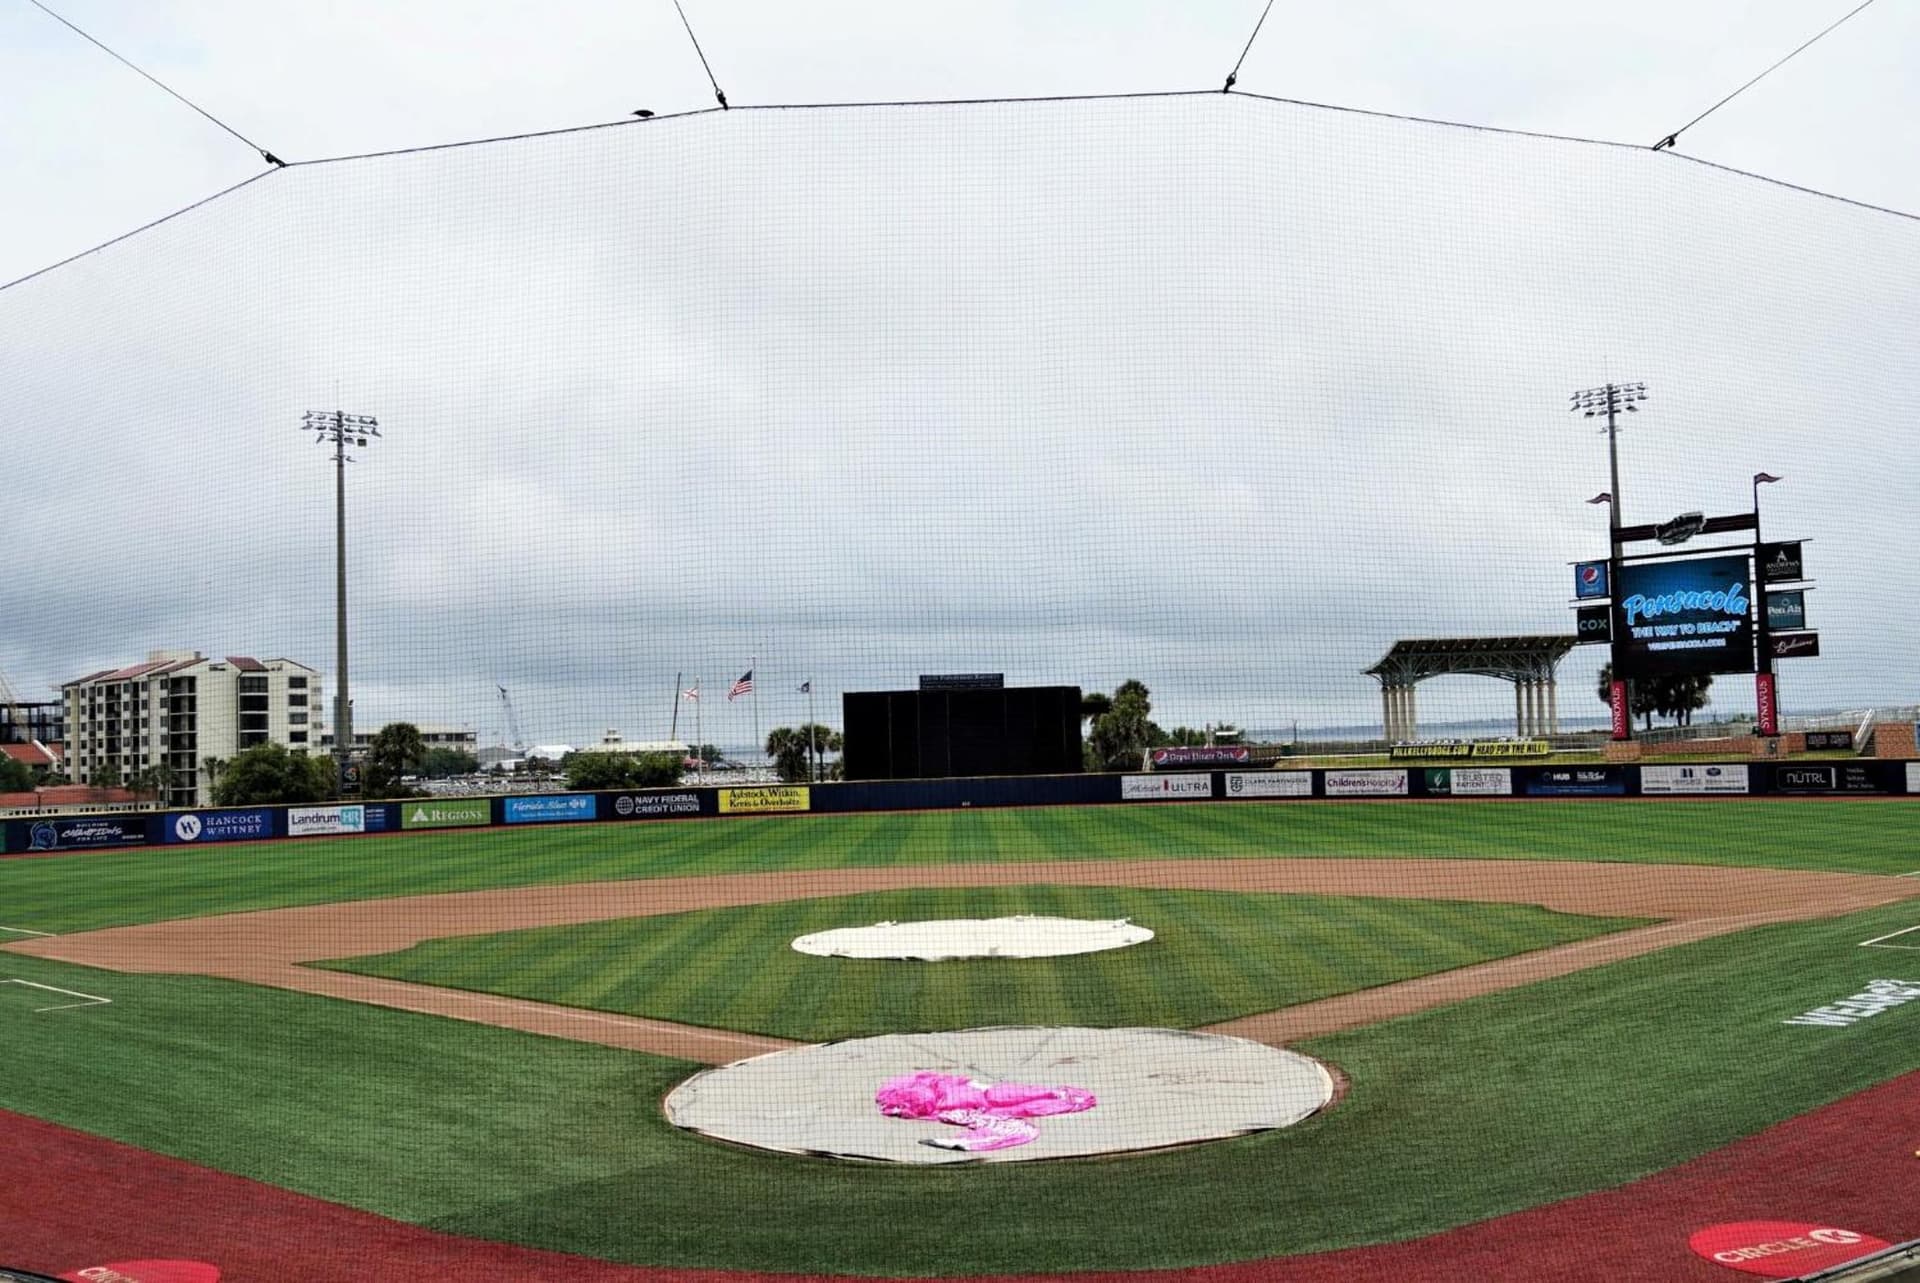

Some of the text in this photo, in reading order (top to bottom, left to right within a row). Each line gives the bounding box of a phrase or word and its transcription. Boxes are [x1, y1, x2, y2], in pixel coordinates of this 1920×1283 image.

[1622, 582, 1749, 626] Pensacola
[1580, 619, 1607, 631] COX
[1632, 626, 1653, 638] THE
[1680, 623, 1695, 635] TO
[1760, 680, 1770, 729] SYNOVUS
[1171, 782, 1209, 792] ULTRA
[635, 794, 698, 805] NAVY FEDERAL
[635, 803, 700, 814] CREDIT UNION
[206, 815, 262, 826] HANCOCK
[206, 824, 261, 836] WHITNEY
[1713, 1237, 1819, 1263] CIRCLE
